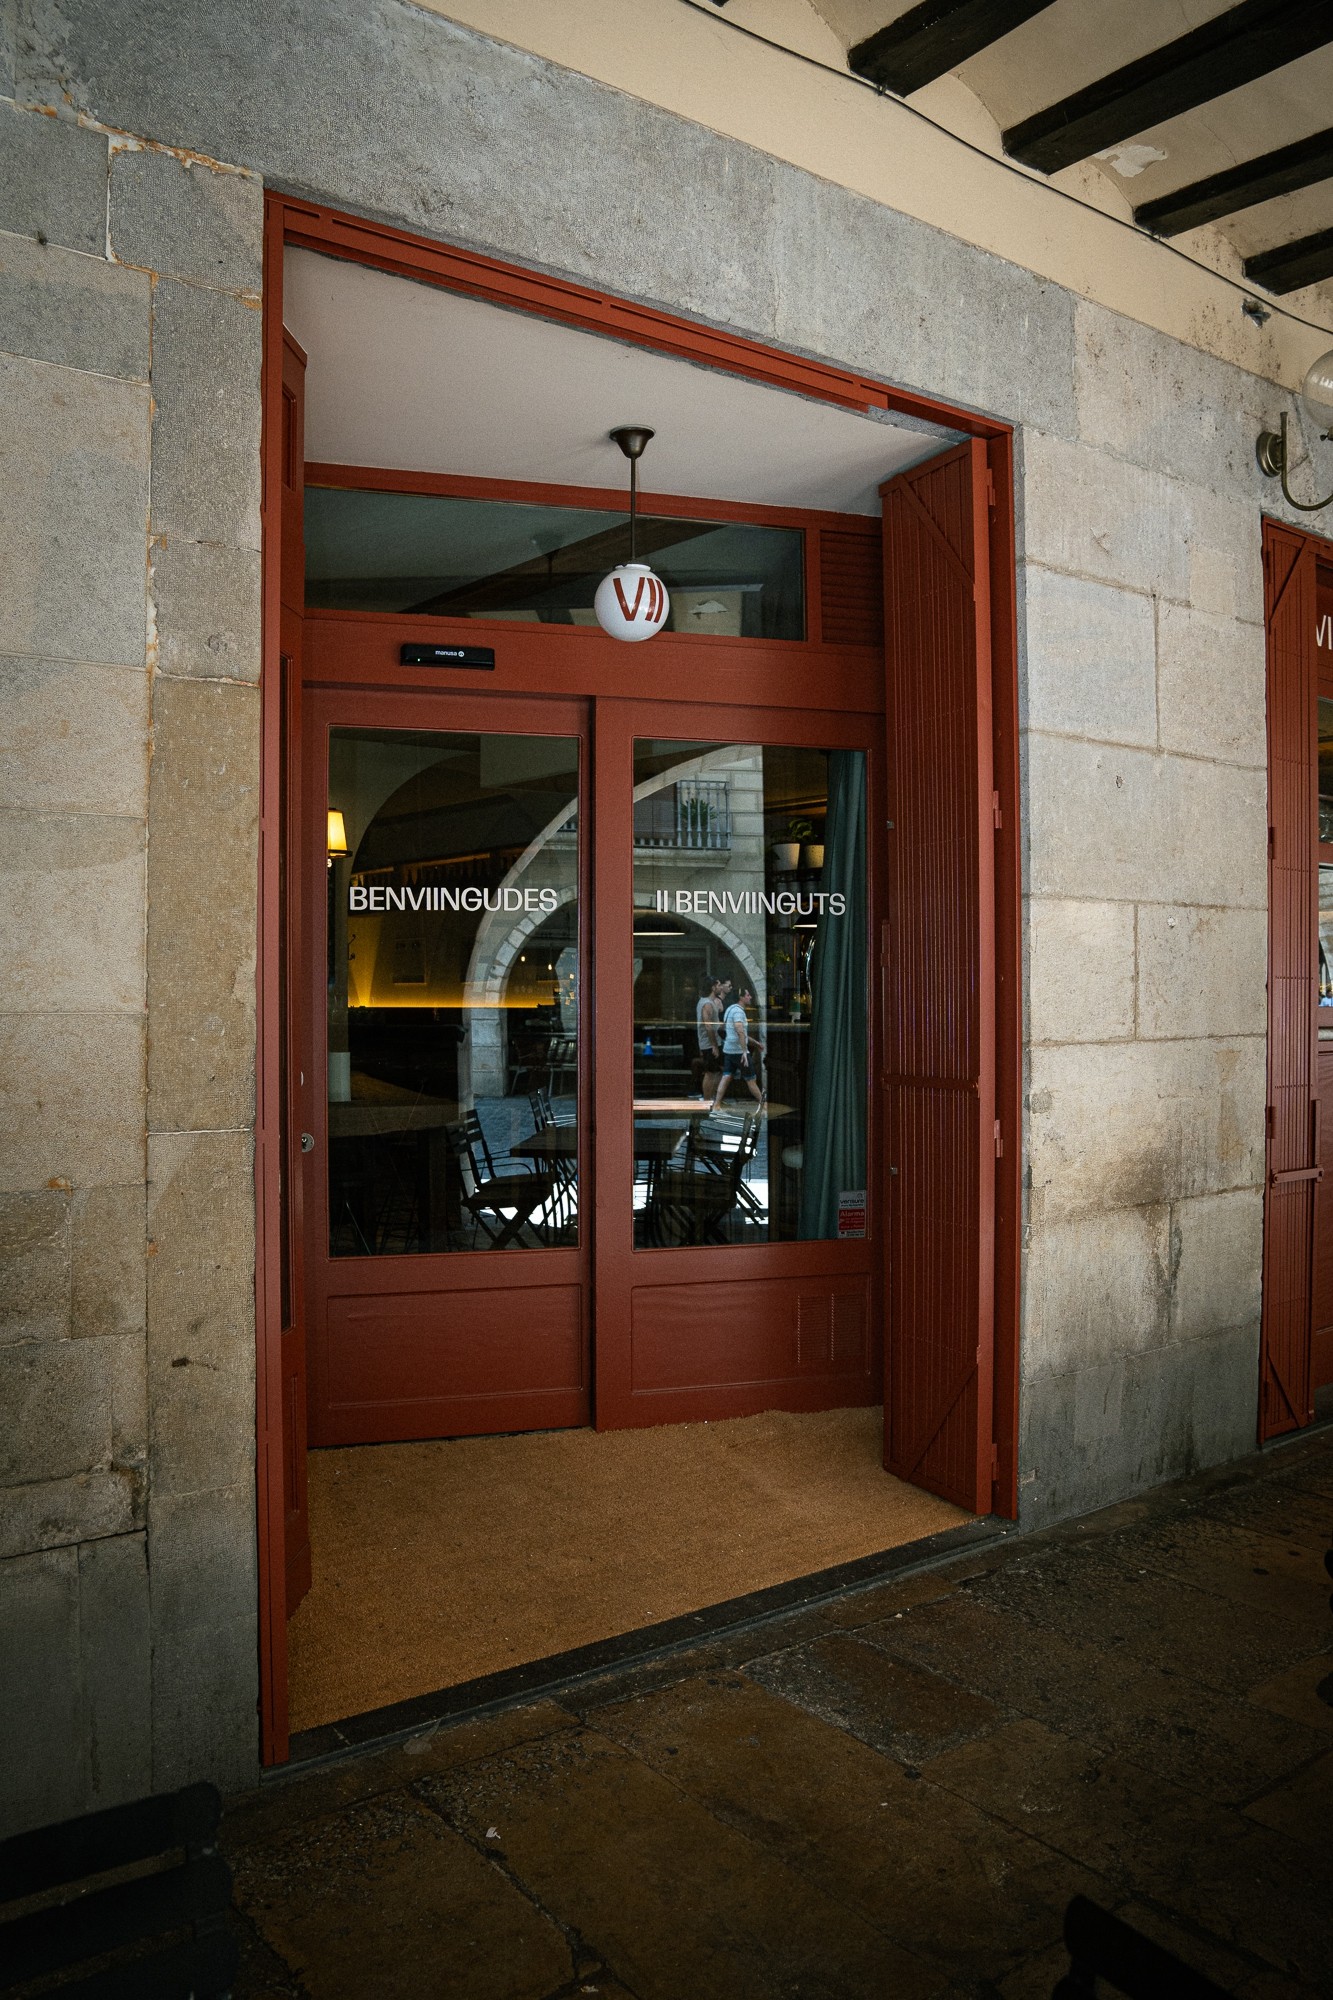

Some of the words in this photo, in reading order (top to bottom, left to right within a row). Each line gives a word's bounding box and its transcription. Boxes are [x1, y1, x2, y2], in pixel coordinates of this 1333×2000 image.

[613, 577, 664, 623] VII
[349, 886, 558, 912] BENVIINGUDES
[675, 890, 846, 916] BENVIINGUTS
